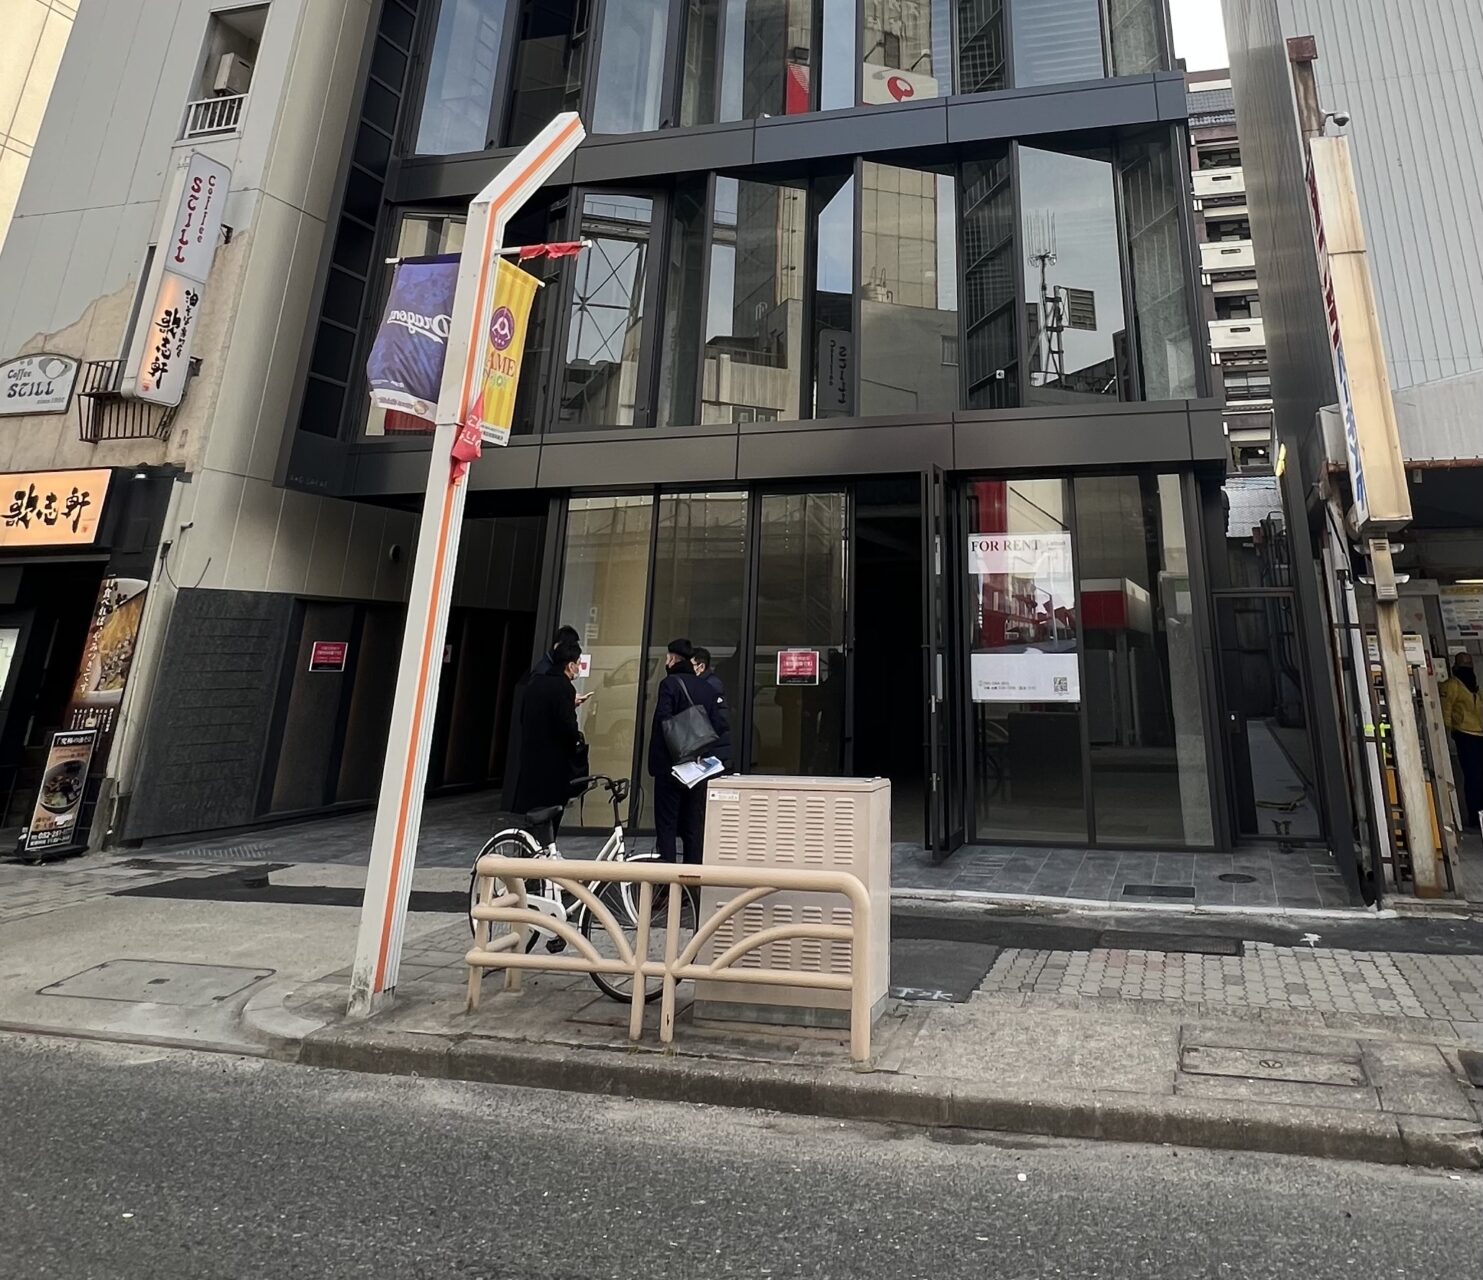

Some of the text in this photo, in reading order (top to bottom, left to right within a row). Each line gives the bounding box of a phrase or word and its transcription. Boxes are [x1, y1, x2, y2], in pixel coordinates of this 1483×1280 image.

[8, 368, 32, 381] Coffee
[7, 381, 55, 398] STILL
[971, 540, 999, 552] FOR
[1003, 539, 1041, 552] RENT
